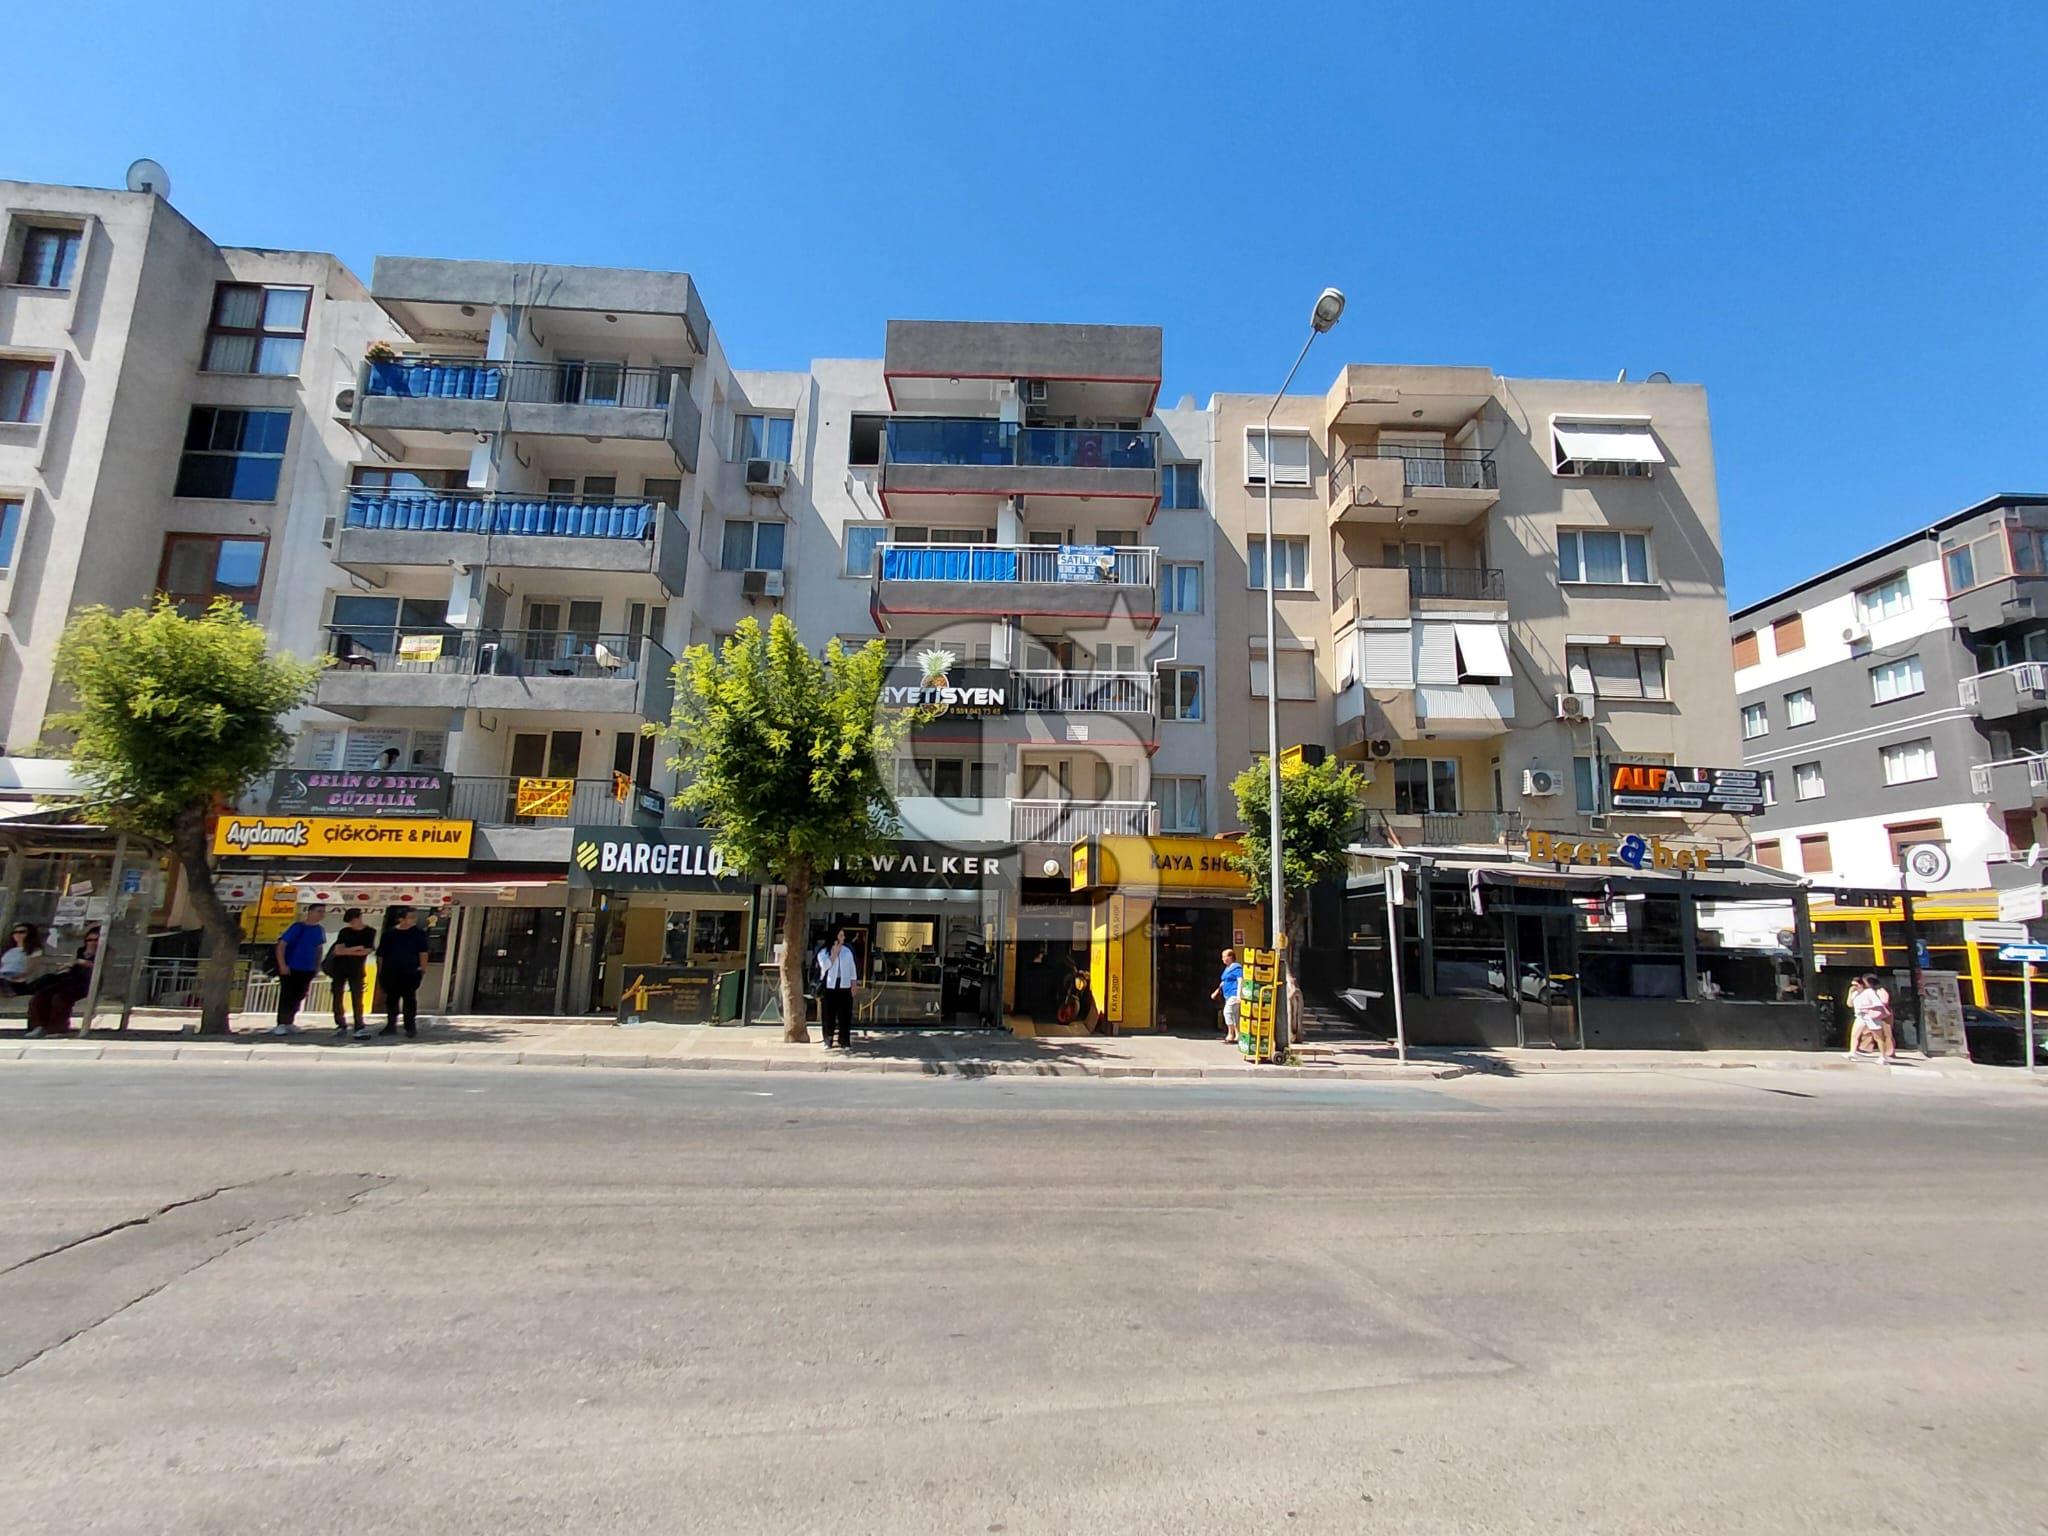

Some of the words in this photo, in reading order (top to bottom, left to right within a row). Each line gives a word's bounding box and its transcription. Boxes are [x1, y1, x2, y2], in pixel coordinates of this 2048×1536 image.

[1060, 555, 1098, 565] SATILIK
[881, 686, 1005, 705] İYETİSYEN
[308, 771, 362, 787] SELİN
[1613, 767, 1682, 793] ALFA
[328, 789, 418, 807] GÜZELLİK
[227, 820, 309, 849] Aydamak
[324, 825, 403, 844] ÇİĞKÖFTE
[408, 829, 418, 842] &
[421, 826, 462, 843] PİLAV
[601, 842, 725, 876] BARGELLO
[1152, 855, 1194, 871] KAYA
[1198, 856, 1241, 872] SHO
